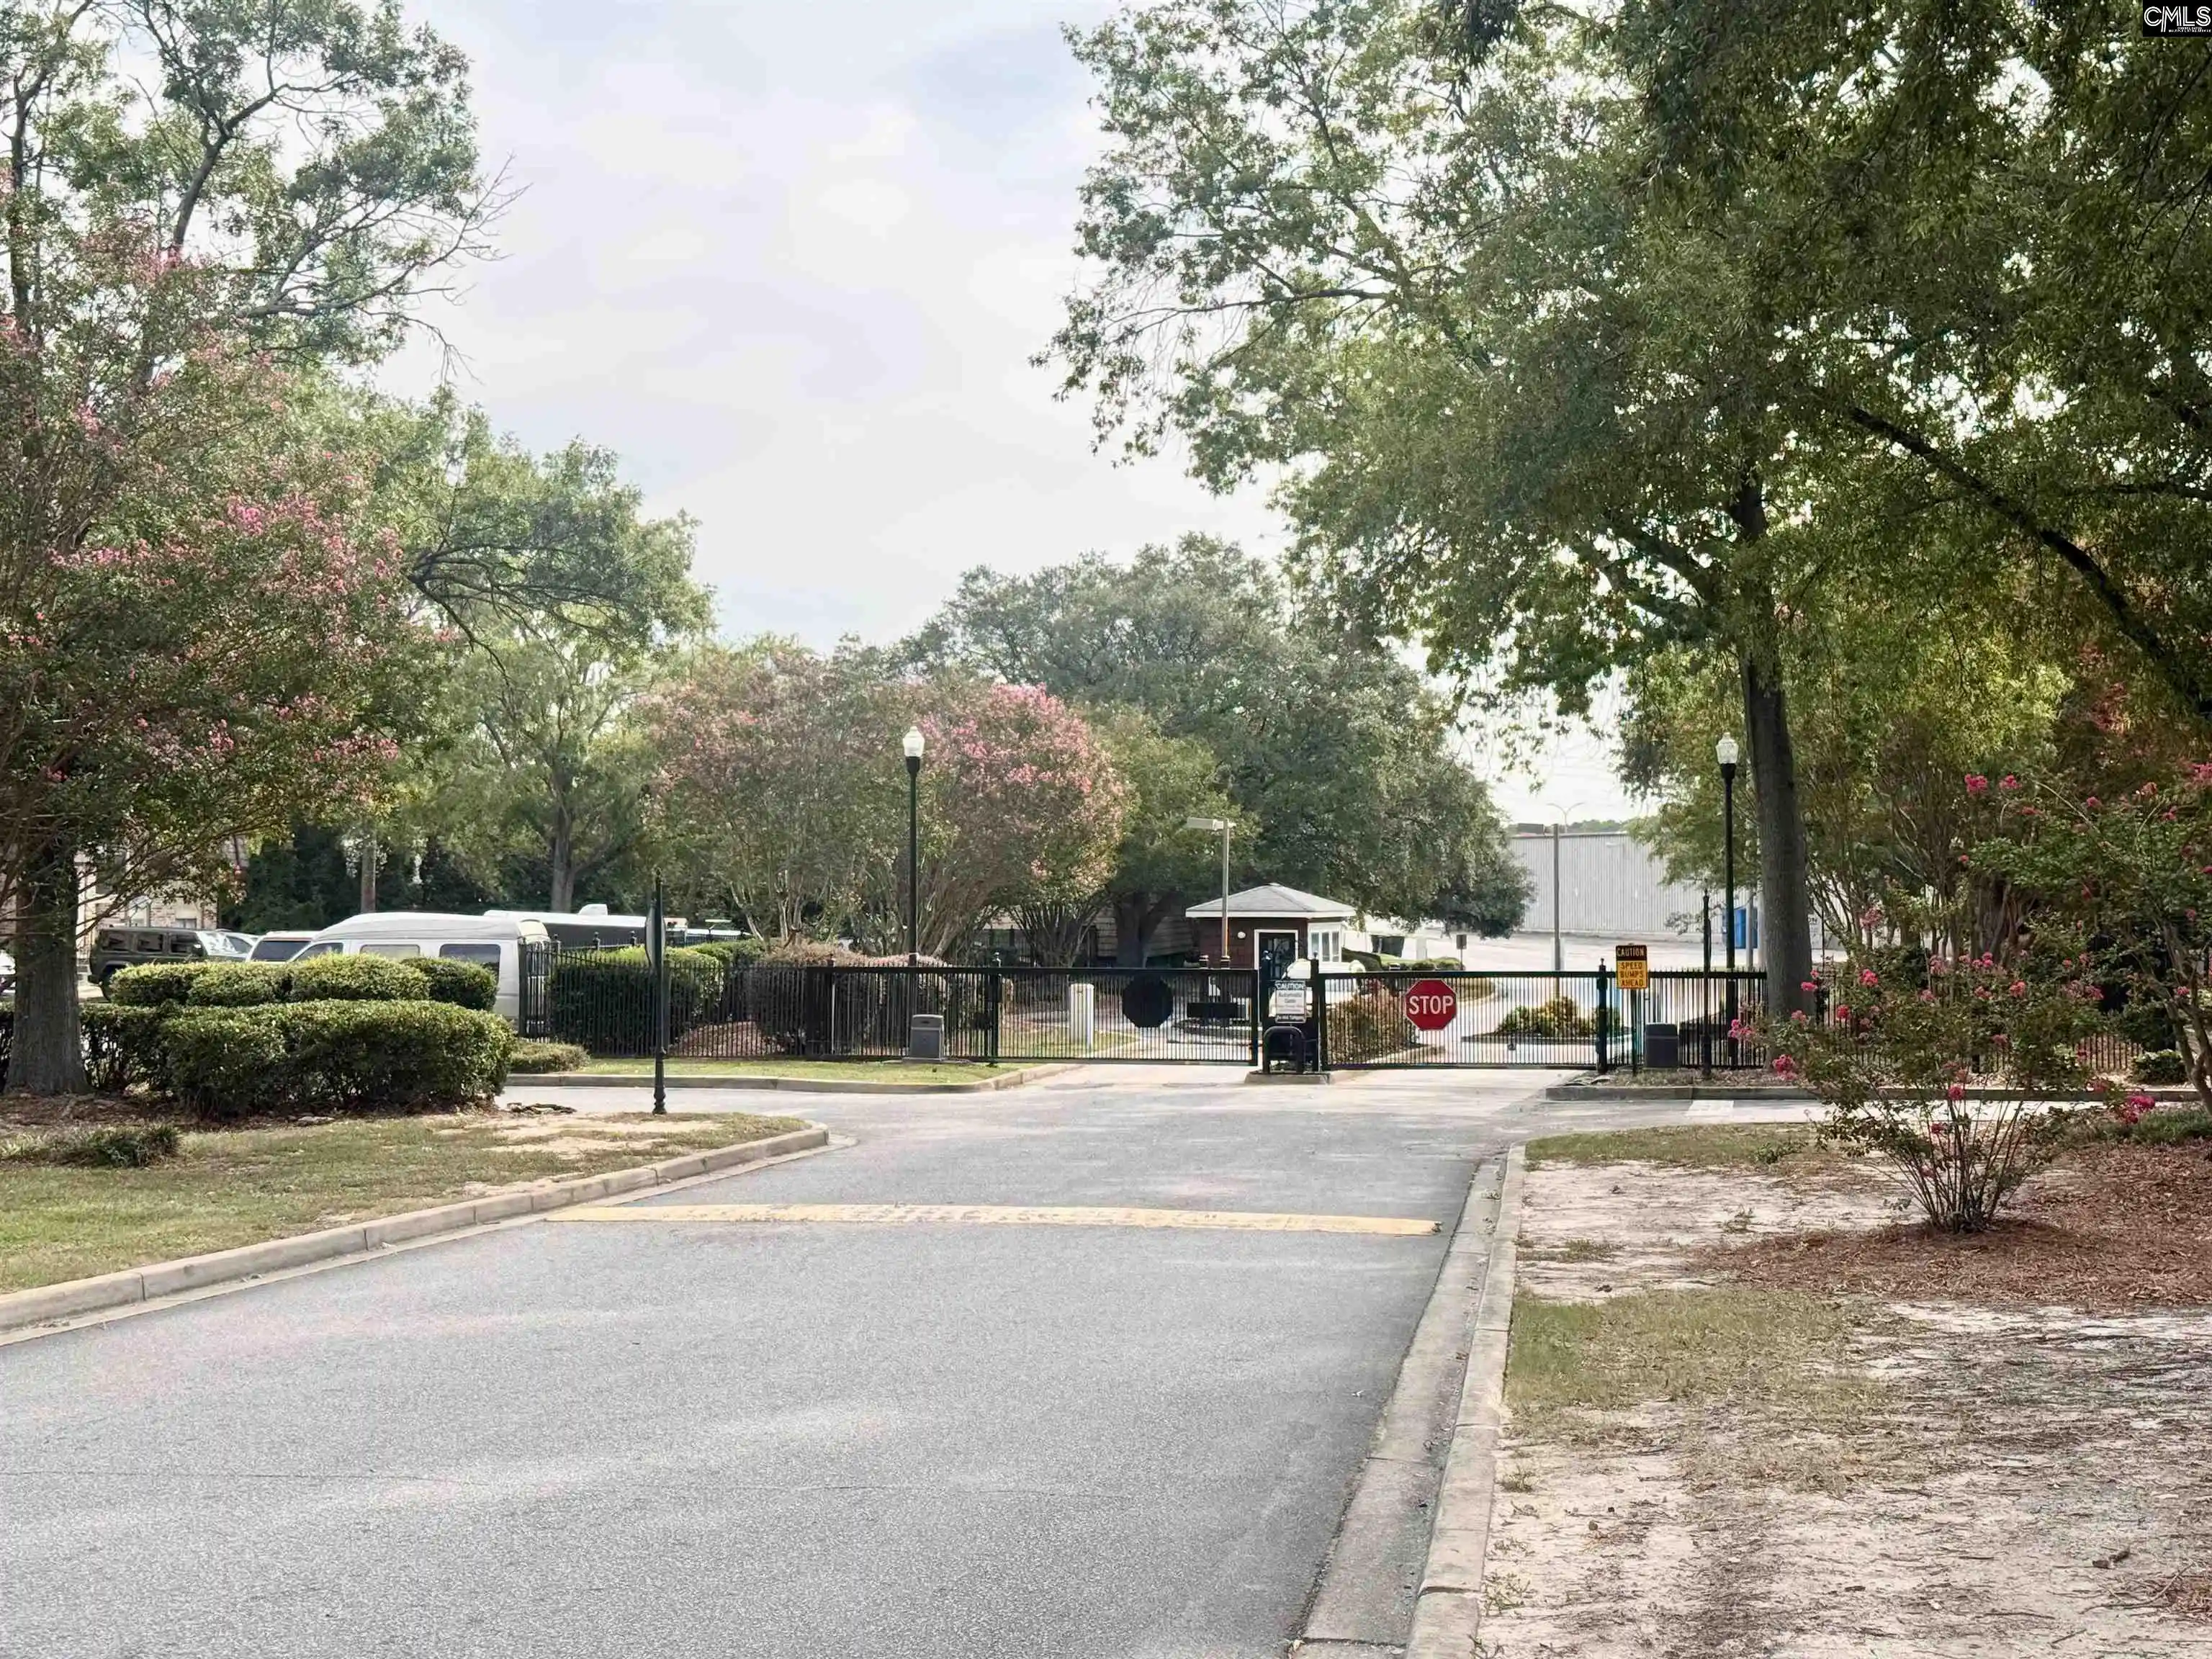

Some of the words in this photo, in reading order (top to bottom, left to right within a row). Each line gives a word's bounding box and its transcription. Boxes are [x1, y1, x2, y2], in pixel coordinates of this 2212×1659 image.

[1617, 947, 1645, 957] CAUTION
[1619, 961, 1643, 970] SPEED
[1409, 995, 1454, 1015] STOP
